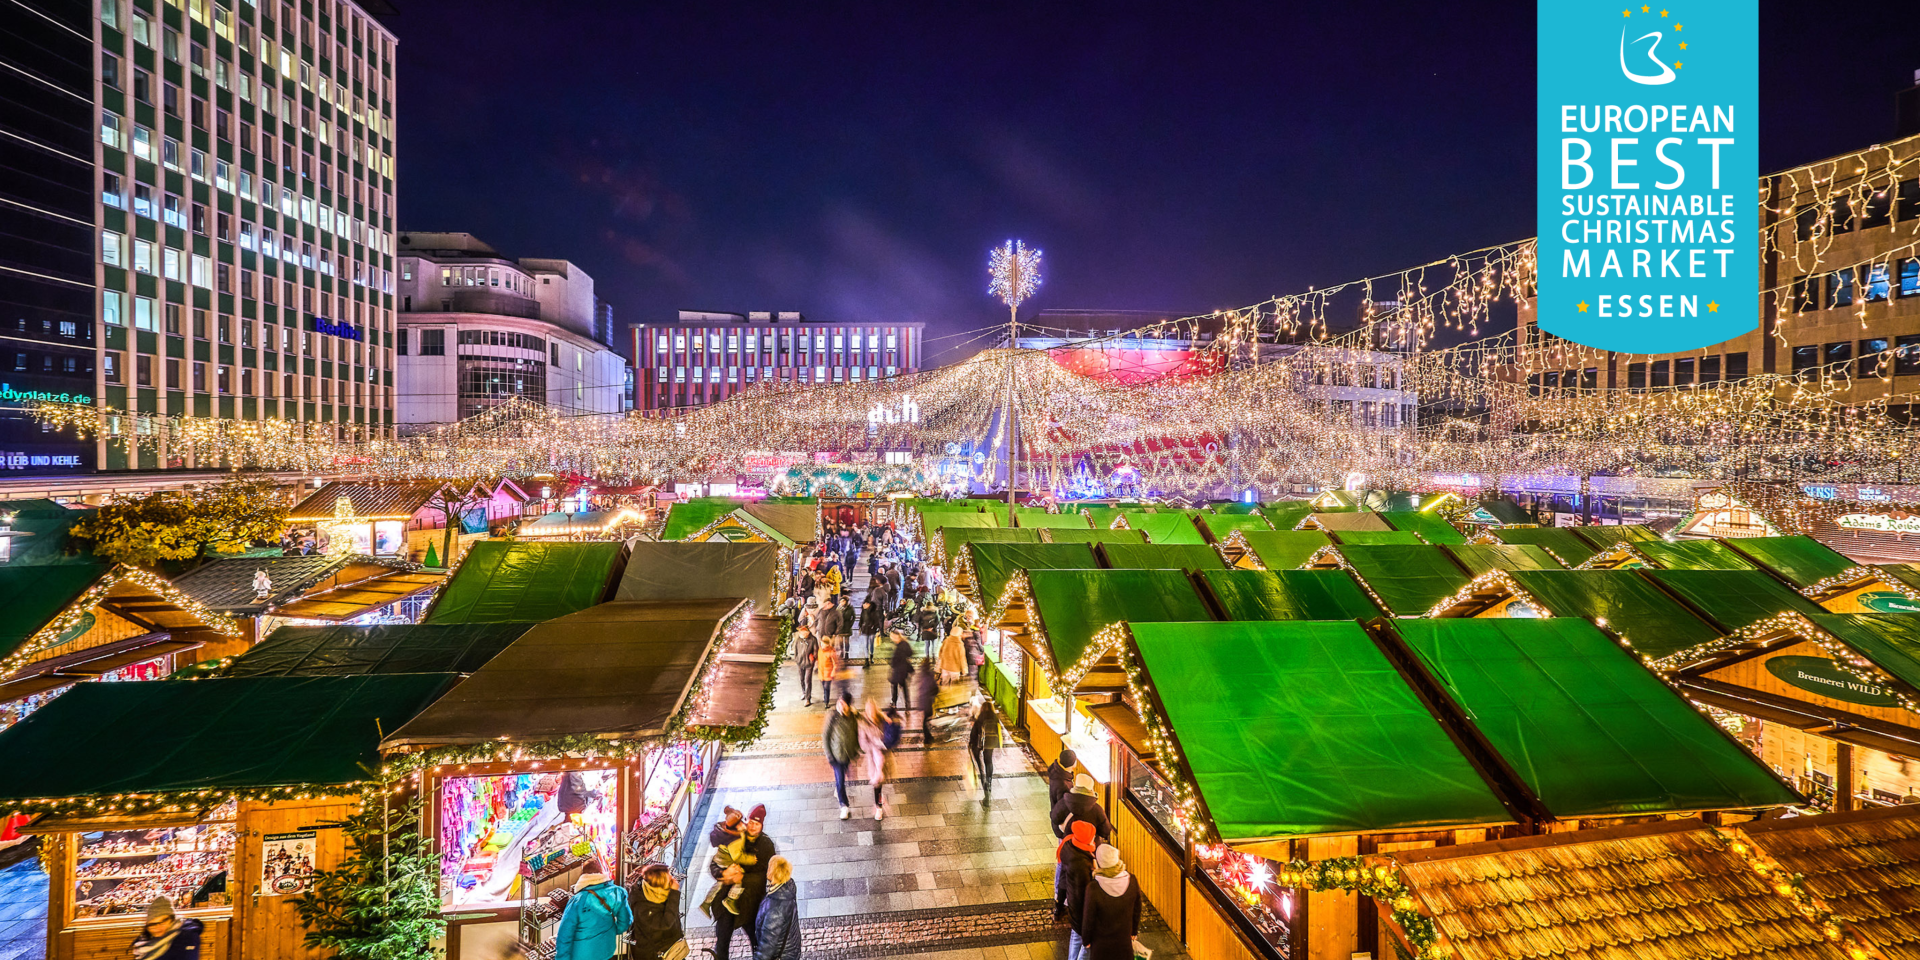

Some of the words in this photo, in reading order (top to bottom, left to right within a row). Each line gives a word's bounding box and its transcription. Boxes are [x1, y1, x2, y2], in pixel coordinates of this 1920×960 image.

[316, 317, 362, 341] Berlitz
[0, 388, 91, 404] dyplatz6.de
[7, 456, 29, 466] LEIB
[30, 456, 50, 466] UND
[1804, 486, 1836, 499] SENSE
[1841, 516, 1881, 528] Adam's
[1798, 670, 1845, 688] Brennerei
[1847, 681, 1881, 696] WILD
